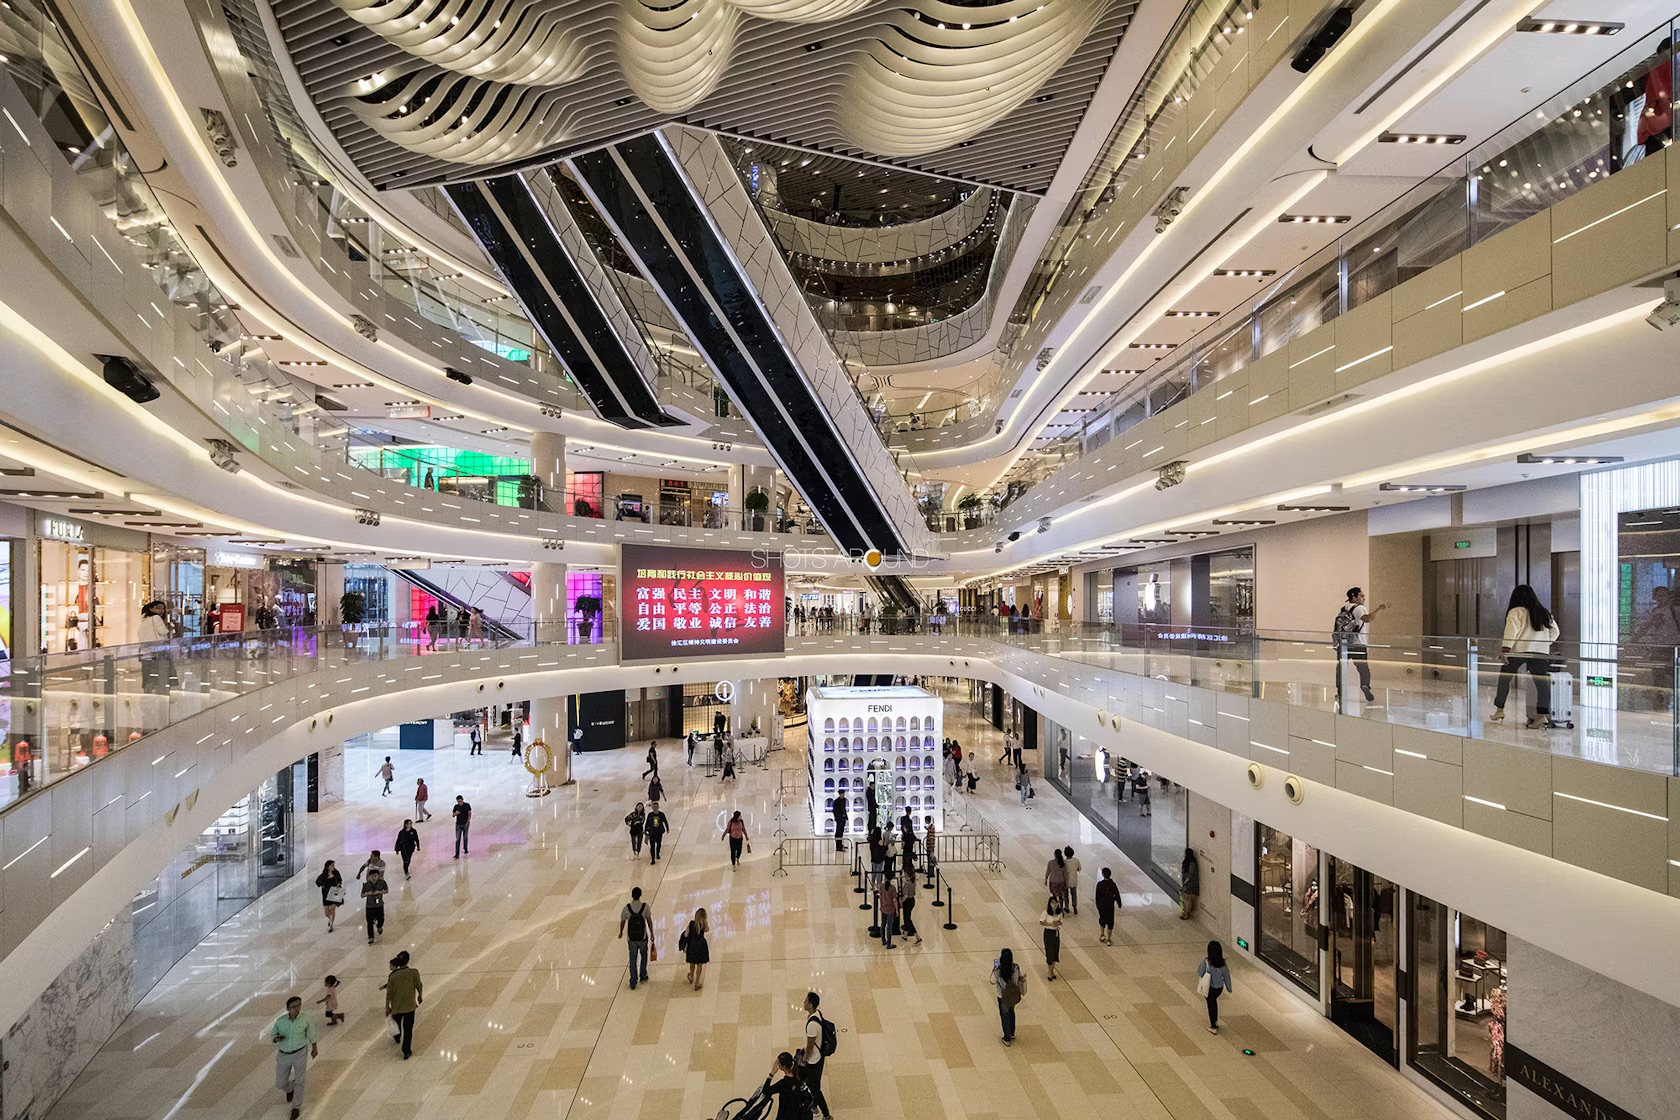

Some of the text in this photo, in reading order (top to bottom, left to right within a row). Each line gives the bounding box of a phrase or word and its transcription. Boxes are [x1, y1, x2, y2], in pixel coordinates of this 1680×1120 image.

[49, 520, 84, 539] FURLA
[636, 568, 772, 582] 培育和践行社会主义核心价值观
[636, 586, 772, 601] 富强 民主 文明 和谐
[638, 602, 772, 616] 自由 平等 公正 法治
[636, 615, 772, 631] 爱国 敬业 诚信 友善
[867, 704, 893, 713] FENDI
[1519, 1064, 1617, 1120] ALEXAND
